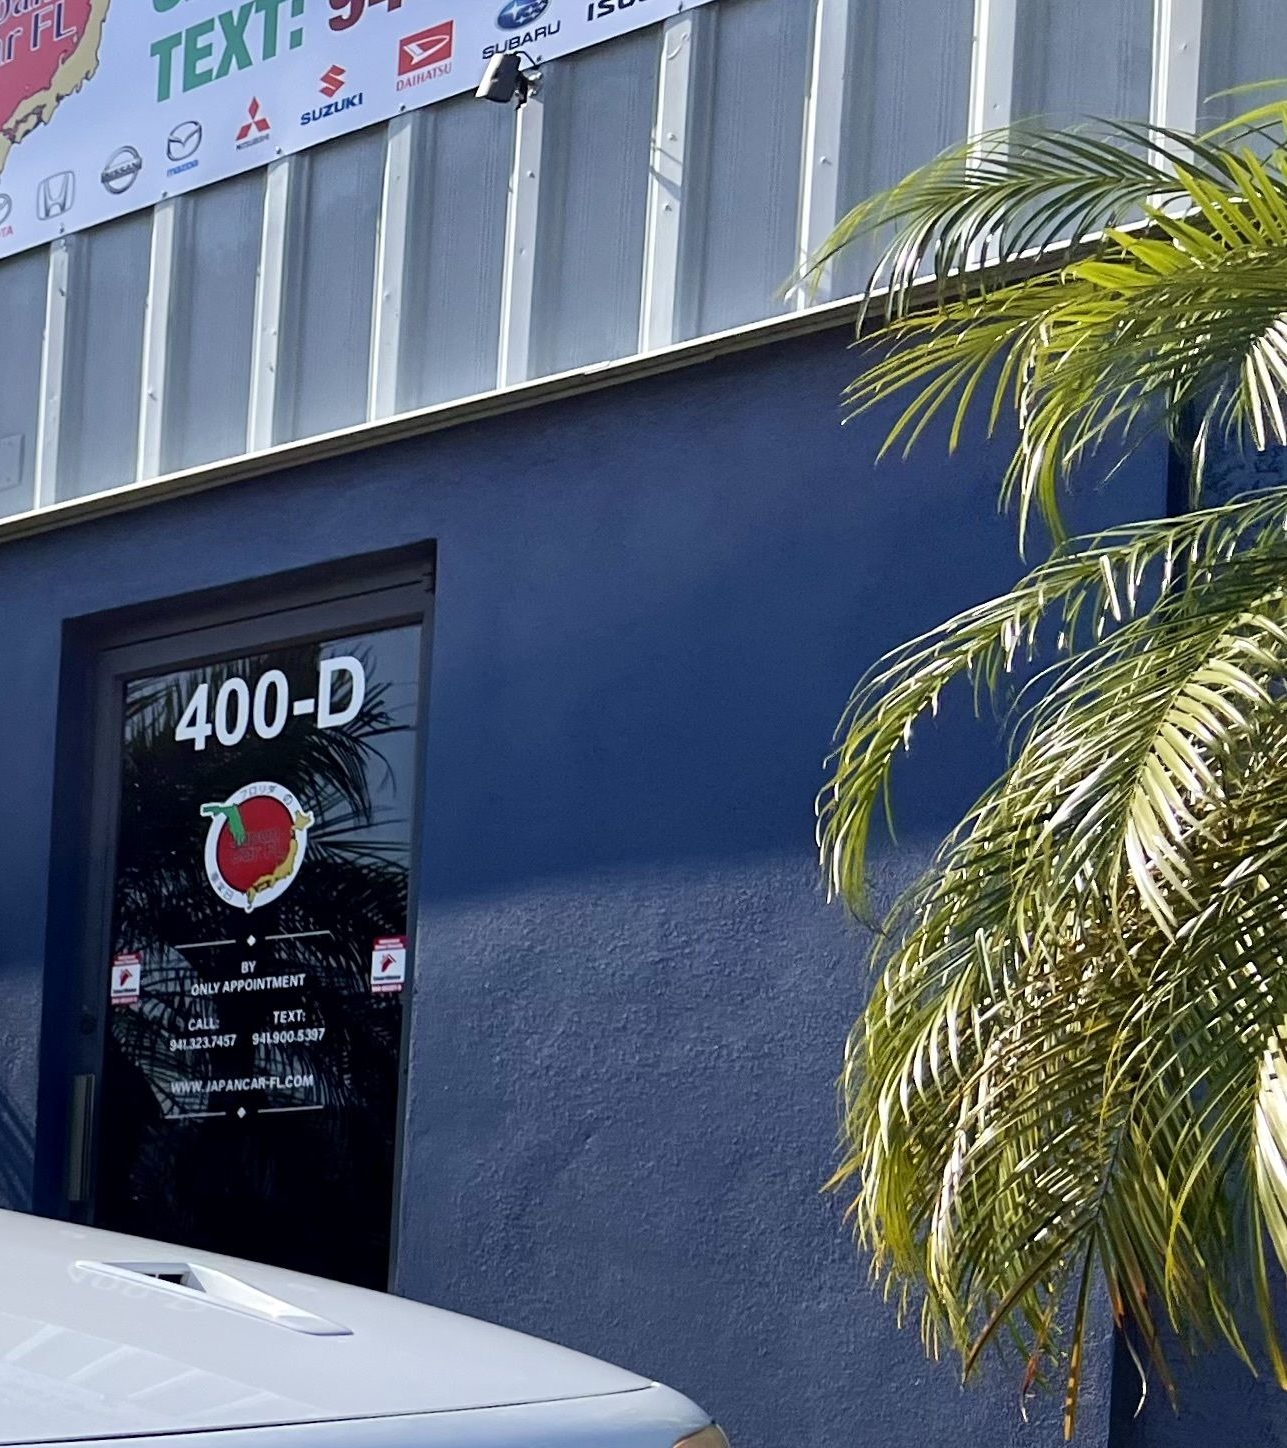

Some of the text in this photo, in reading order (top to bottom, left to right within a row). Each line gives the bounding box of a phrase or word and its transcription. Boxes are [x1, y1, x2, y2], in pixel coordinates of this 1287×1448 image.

[29, 0, 78, 52] FL
[482, 19, 561, 60] SUBARU
[396, 62, 453, 93] DAIHATSU
[300, 92, 364, 126] SUZUKI
[175, 655, 366, 751] 400-D
[241, 960, 257, 974] BY
[191, 973, 306, 996] ONLY APPOINTMENT
[188, 1017, 220, 1031] CALL:
[273, 1008, 306, 1024] TEXT:
[169, 1033, 237, 1052] 941.323.7457
